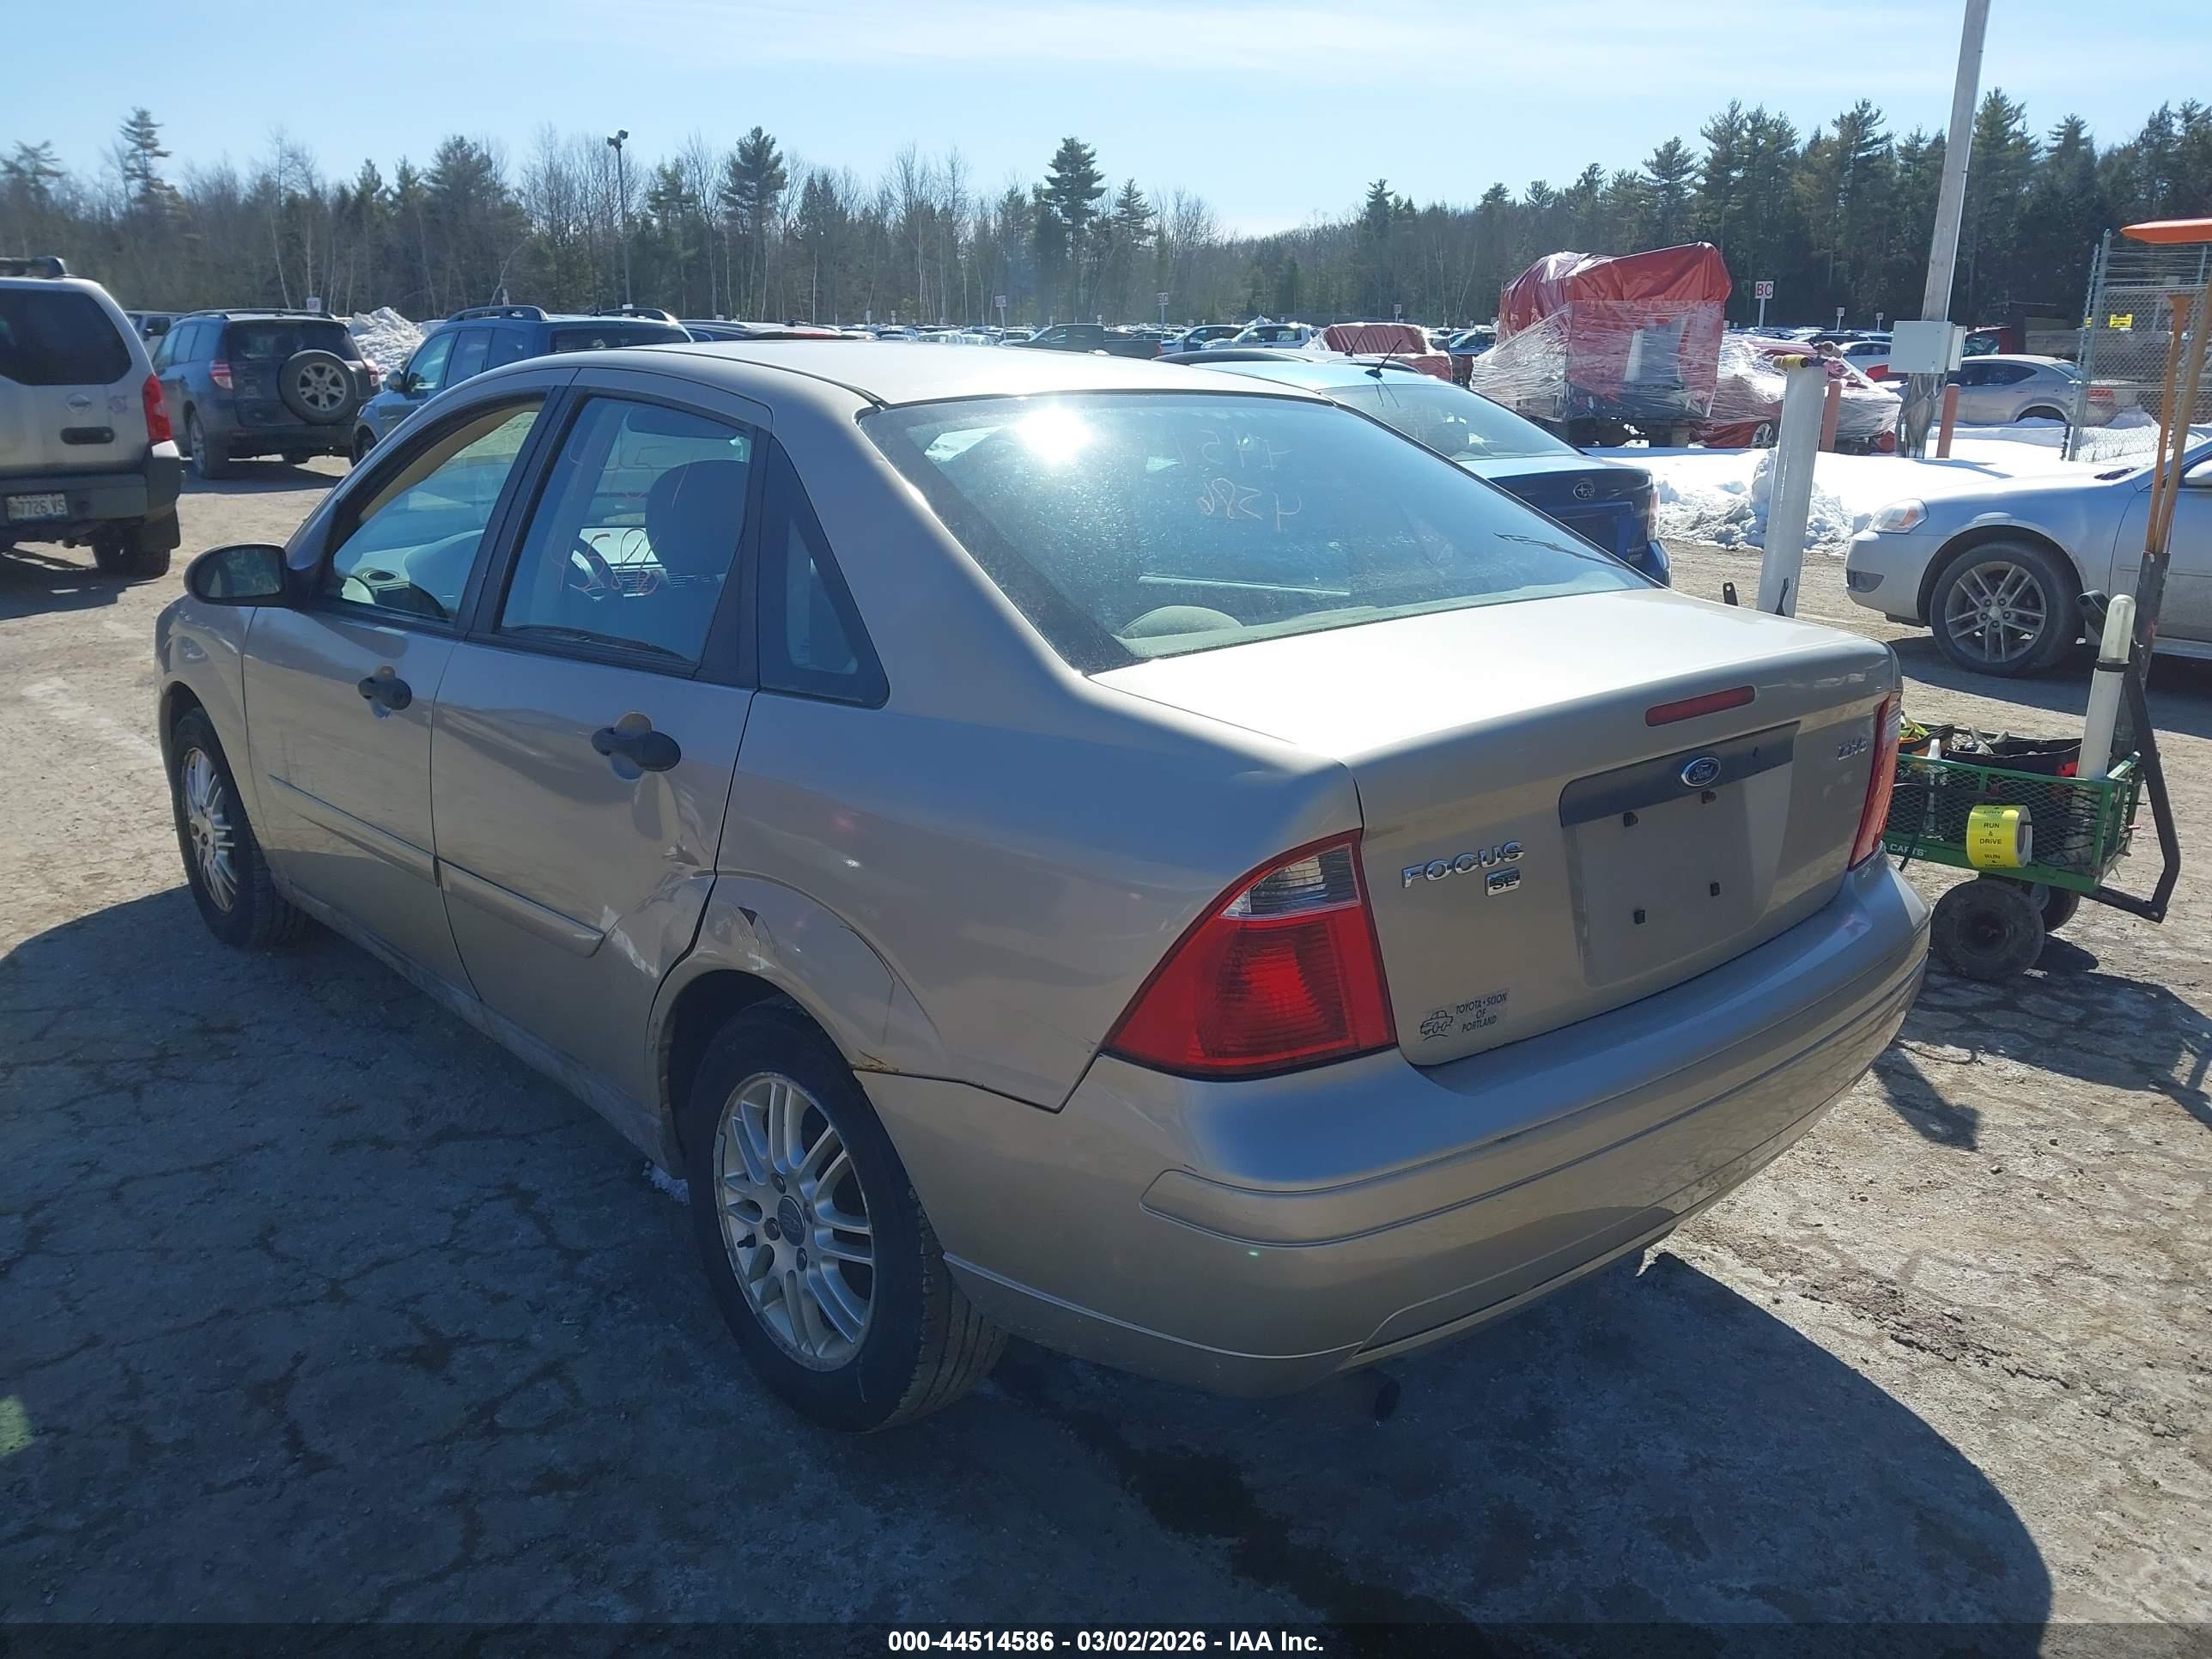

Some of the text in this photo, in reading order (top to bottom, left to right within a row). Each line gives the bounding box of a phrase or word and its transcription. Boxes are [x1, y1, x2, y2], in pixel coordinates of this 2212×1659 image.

[1757, 283, 1772, 296] BC
[1691, 764, 1714, 781] Ford
[1401, 841, 1525, 888] FOCUS
[1489, 874, 1518, 890] SE
[1456, 993, 1507, 1014] TOYOTA SCION
[1476, 1008, 1486, 1019] OF
[1462, 1015, 1498, 1033] PORTLAND
